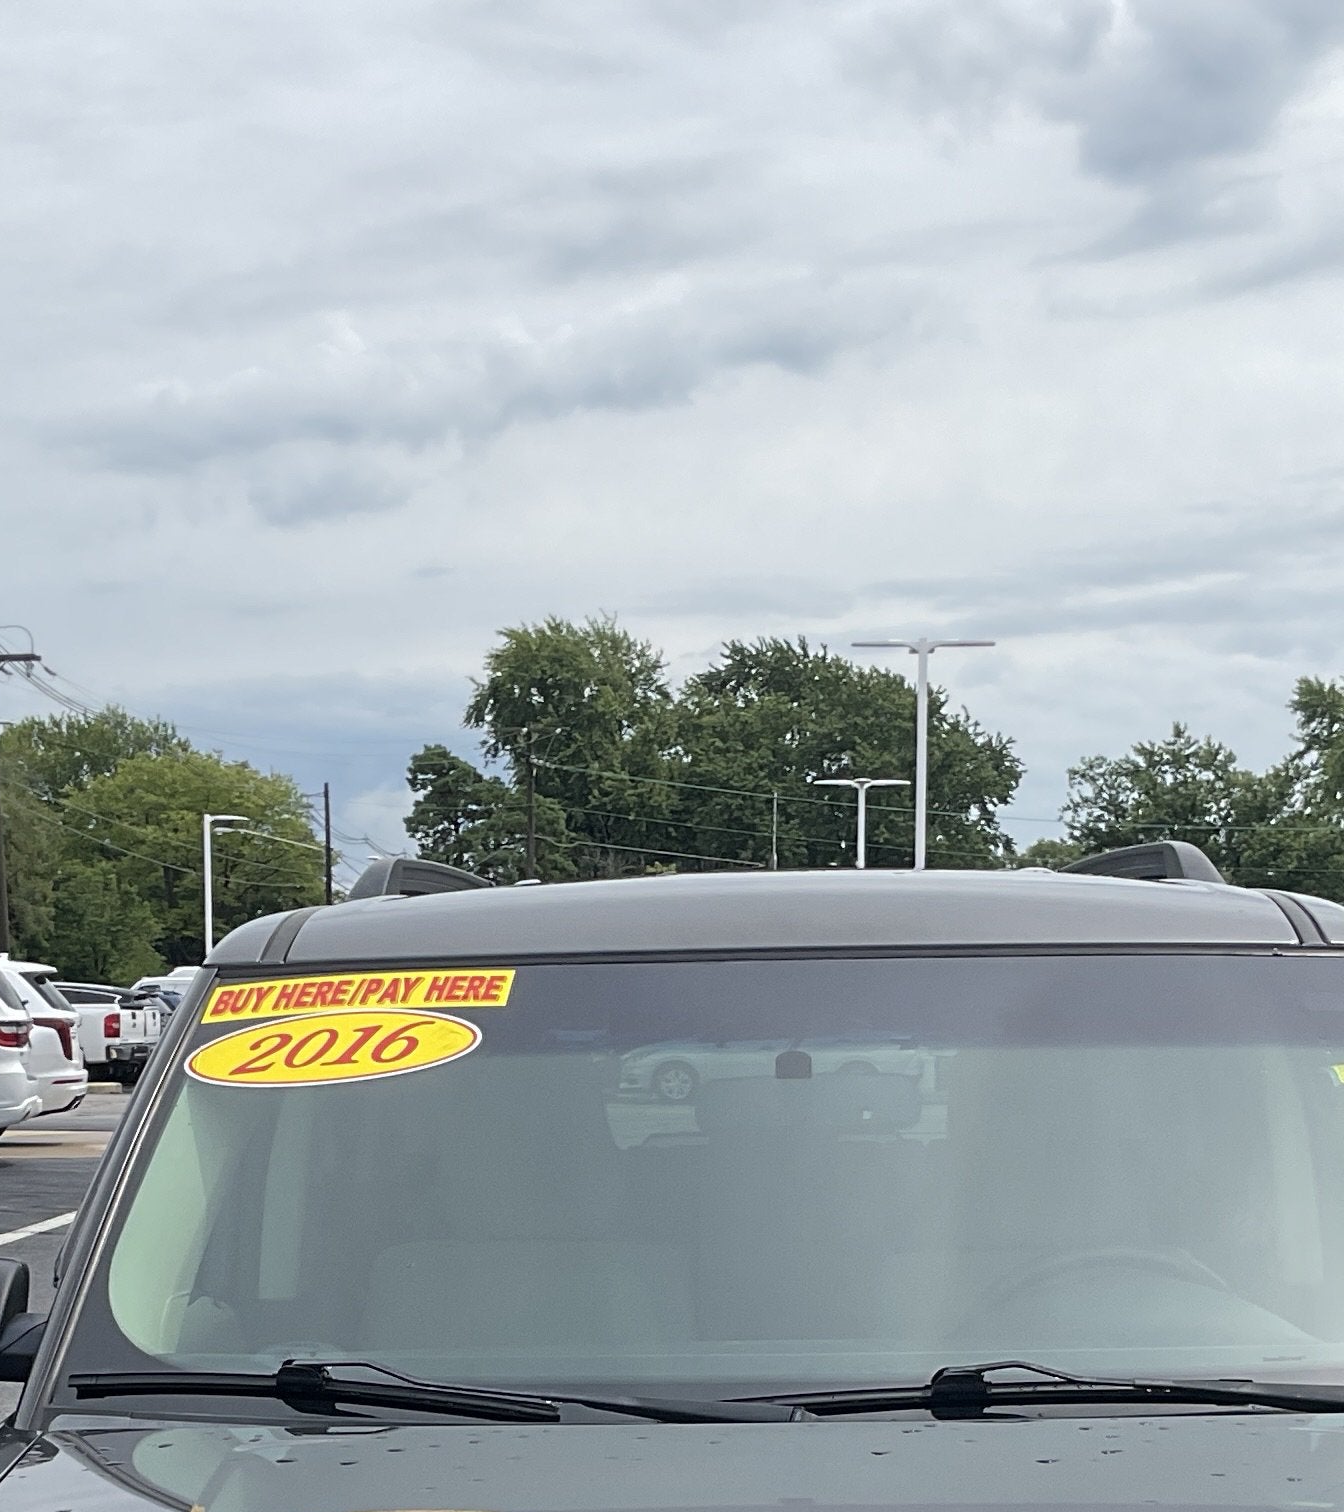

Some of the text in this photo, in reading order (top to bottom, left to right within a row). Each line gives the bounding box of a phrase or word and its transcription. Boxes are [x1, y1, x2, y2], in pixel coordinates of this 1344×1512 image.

[209, 975, 508, 1017] BUY HERE/PAY HERE
[228, 1020, 436, 1076] 2016
